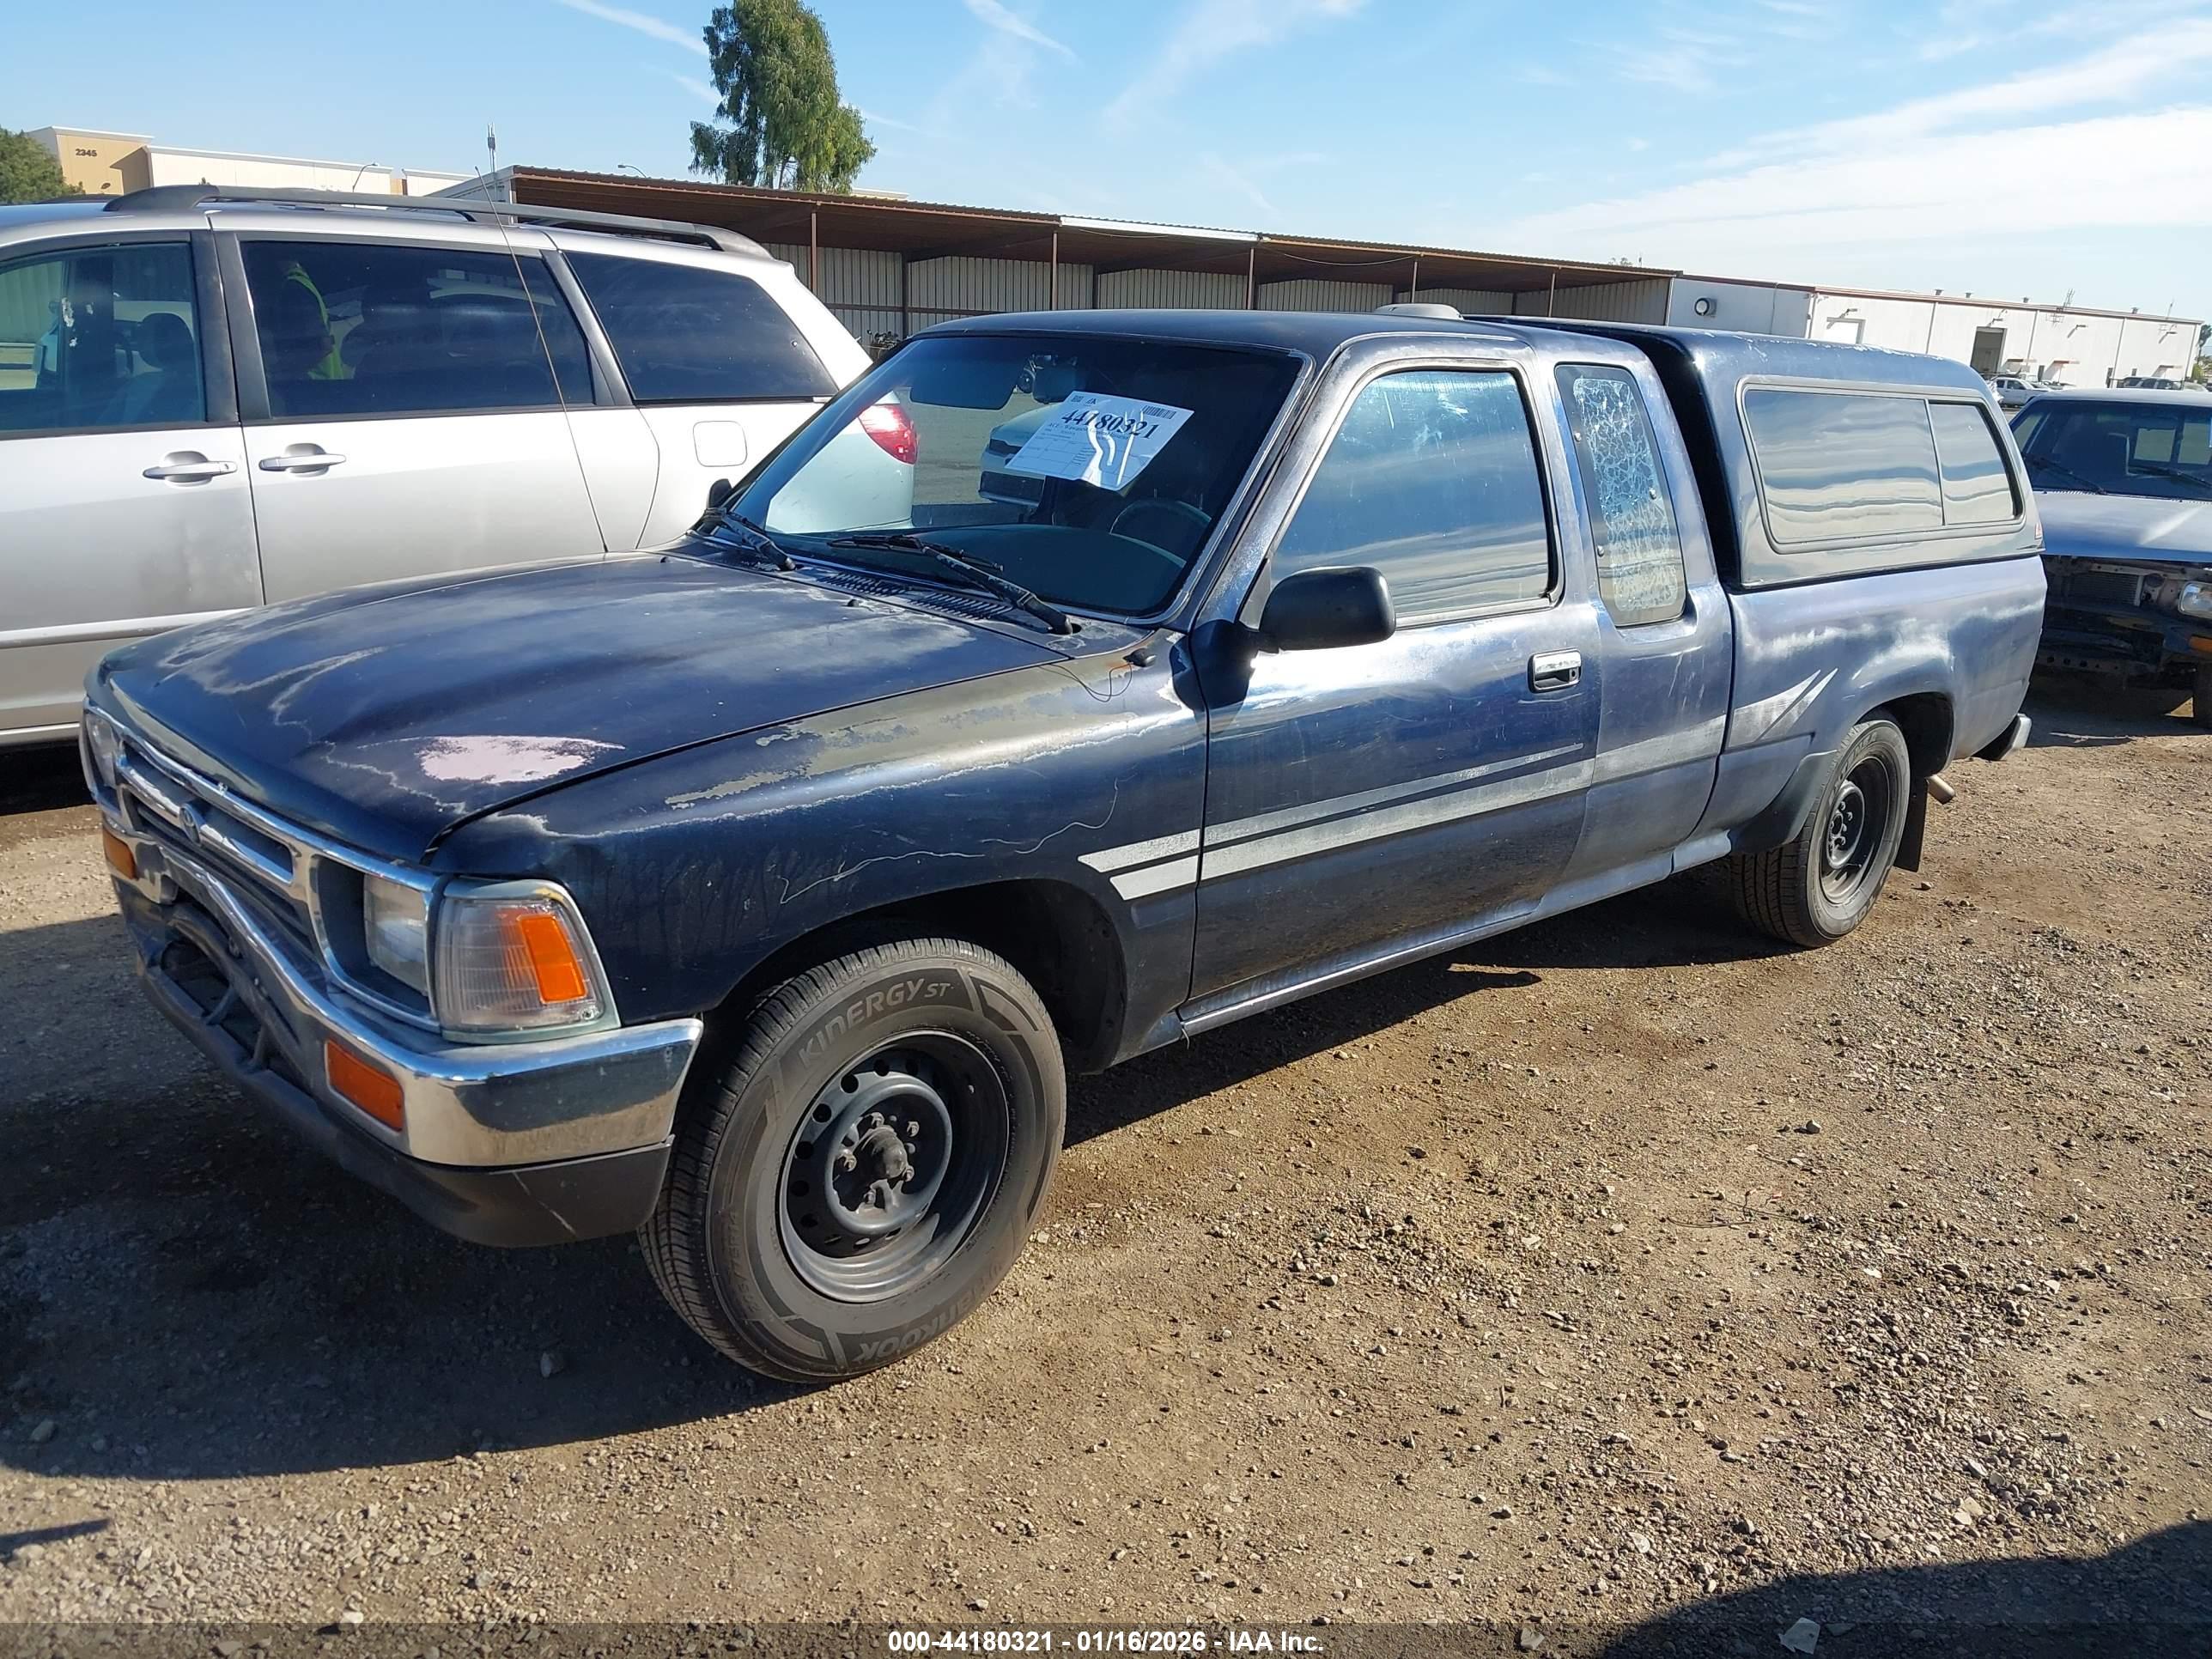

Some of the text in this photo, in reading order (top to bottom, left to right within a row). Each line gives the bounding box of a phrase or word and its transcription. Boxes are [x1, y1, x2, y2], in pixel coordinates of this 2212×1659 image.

[1061, 410, 1161, 439] 44180321
[799, 978, 951, 1069] KINERGY ST
